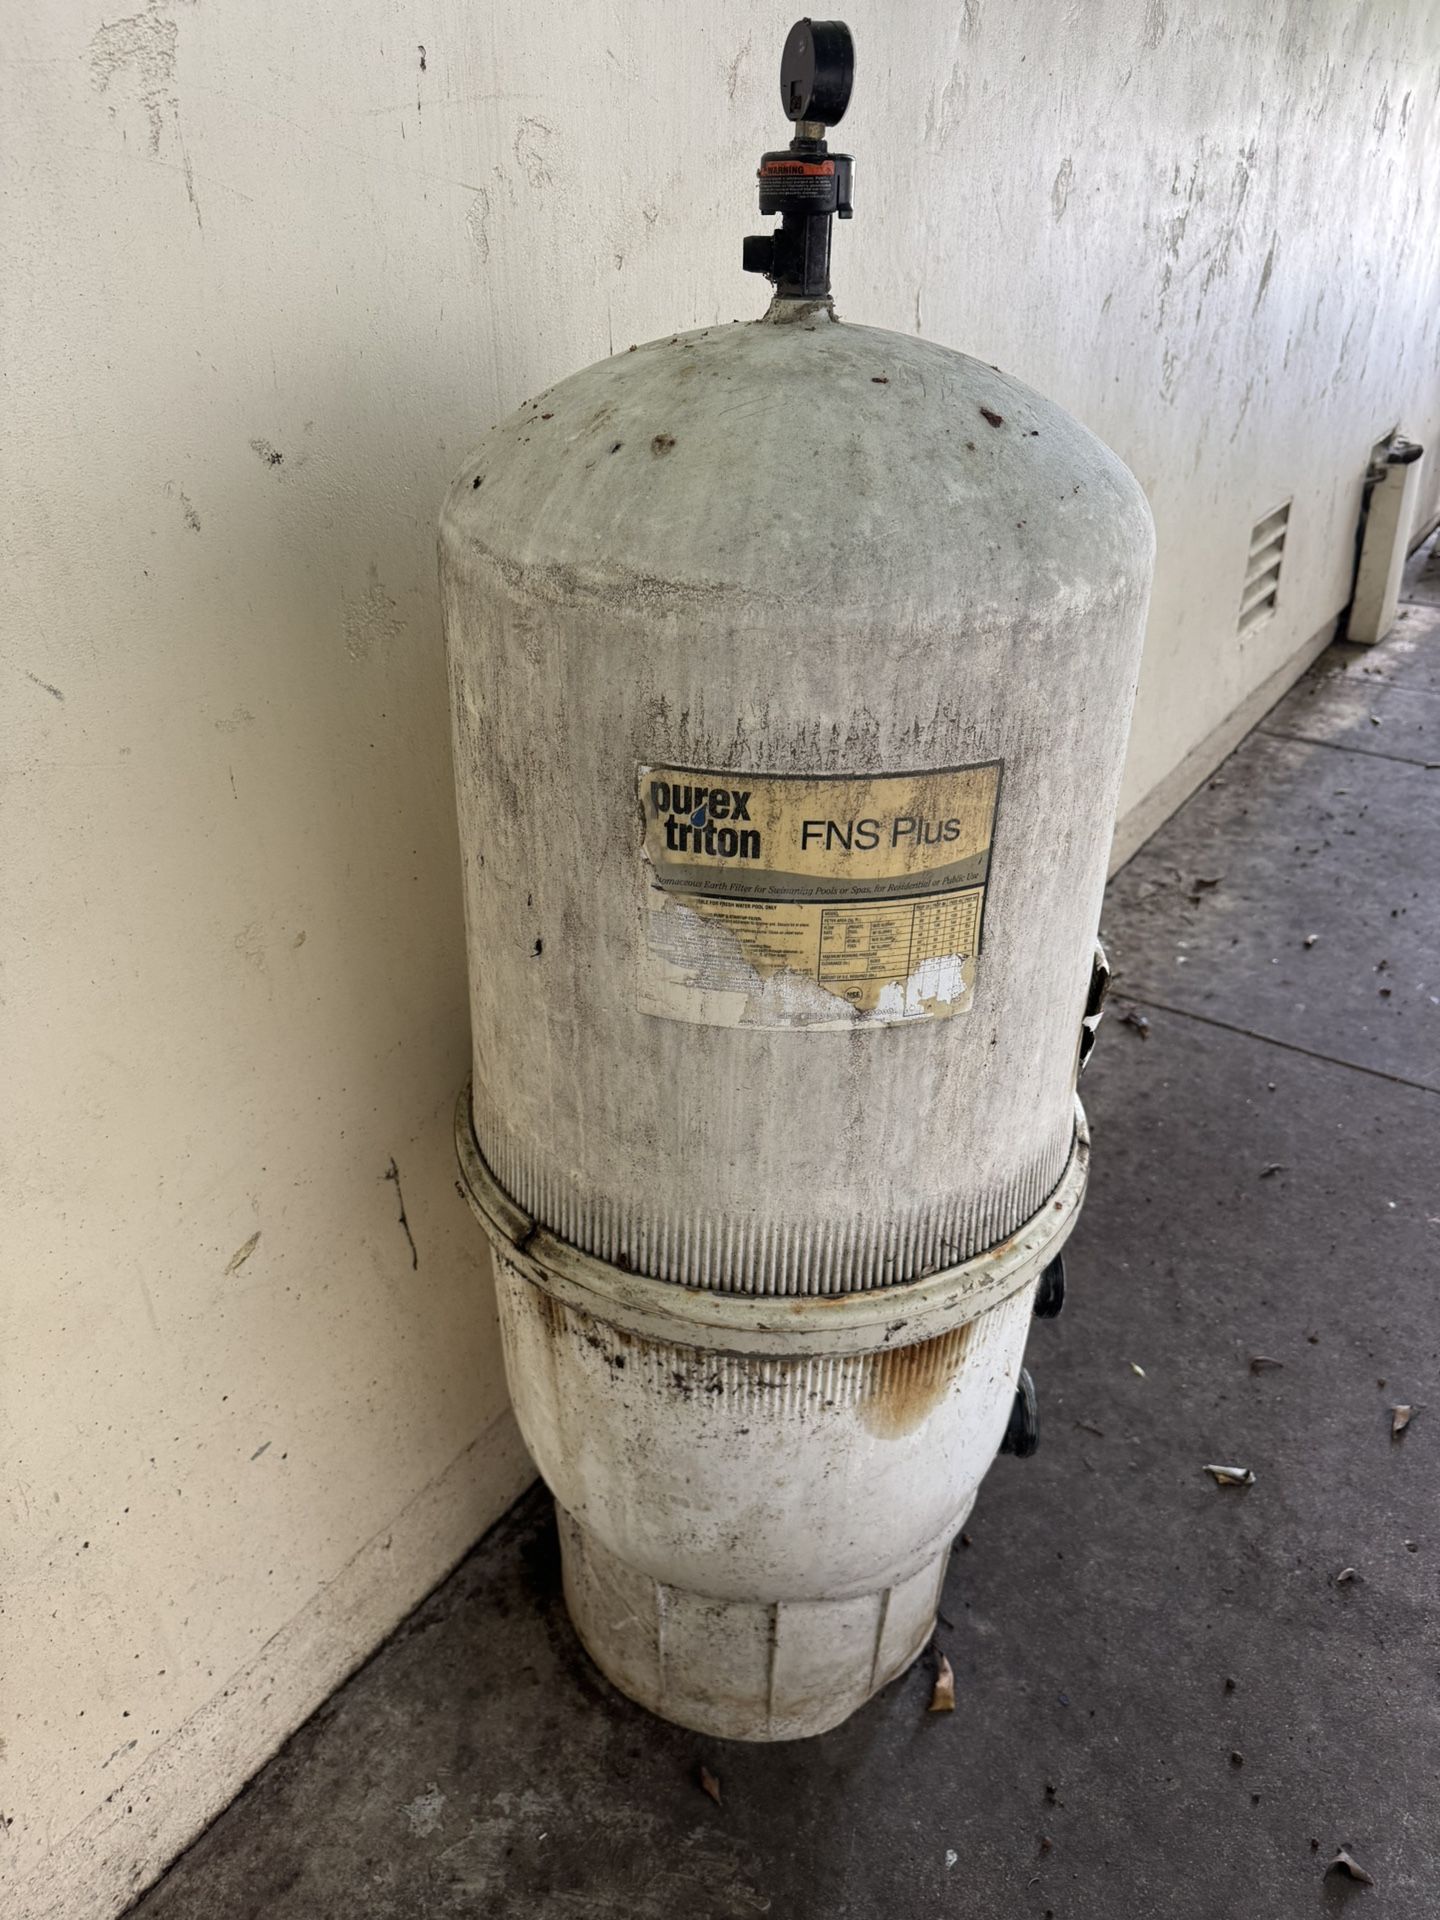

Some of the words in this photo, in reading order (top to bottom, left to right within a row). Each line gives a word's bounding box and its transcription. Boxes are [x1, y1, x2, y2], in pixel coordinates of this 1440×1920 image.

[768, 166, 804, 174] WARNING
[651, 781, 751, 821] purex
[664, 815, 760, 859] triton
[801, 819, 880, 851] FNS
[892, 818, 961, 847] Plus
[704, 881, 728, 891] Earth
[730, 882, 752, 893] Filter
[754, 884, 766, 894] for
[768, 886, 813, 896] Swimming
[815, 885, 838, 895] Pools
[851, 885, 871, 896] Spas,
[874, 884, 886, 892] for
[888, 879, 930, 891] Residential
[932, 879, 940, 887] or
[942, 875, 965, 886] Public
[967, 872, 979, 880] Use
